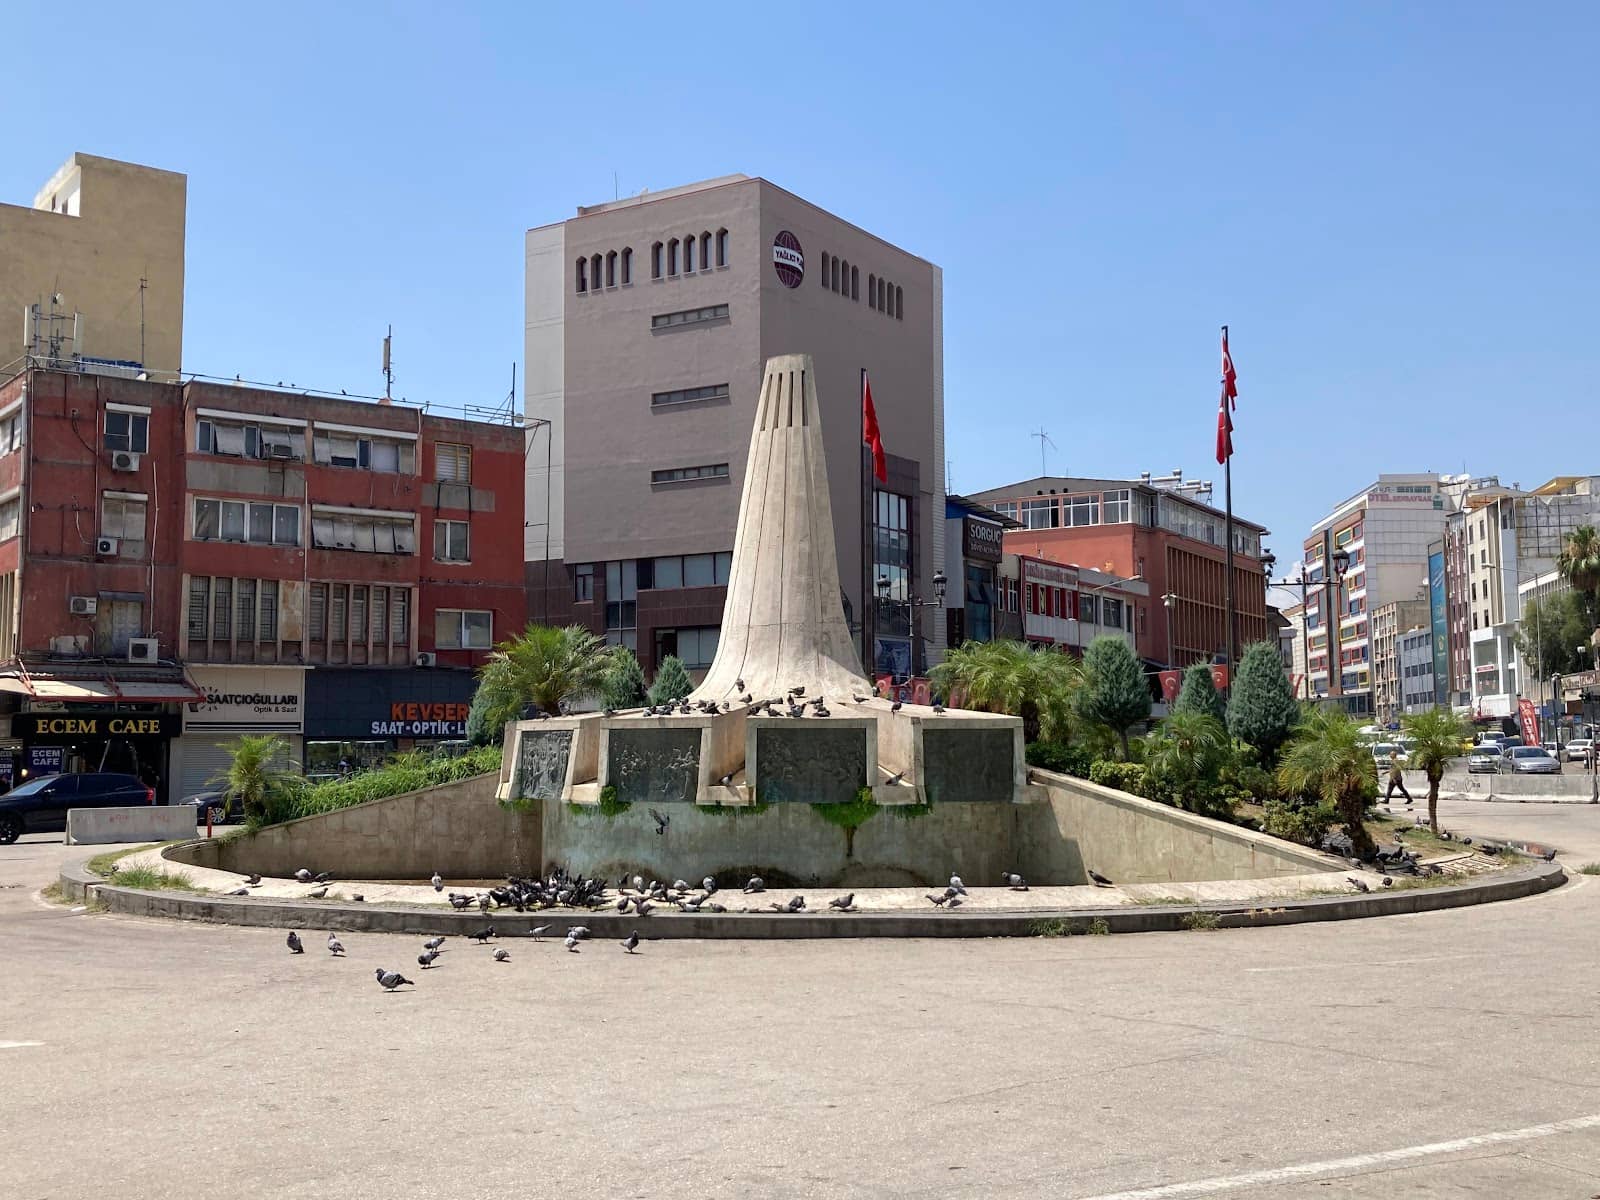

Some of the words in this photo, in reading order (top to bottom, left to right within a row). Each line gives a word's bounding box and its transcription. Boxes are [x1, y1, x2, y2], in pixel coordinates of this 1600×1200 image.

[253, 706, 273, 714] Optik
[391, 703, 470, 721] KEVSER
[36, 719, 97, 734] ECEM
[108, 719, 160, 734] CAFE
[32, 750, 61, 758] ECEM
[32, 758, 60, 766] CAFE
